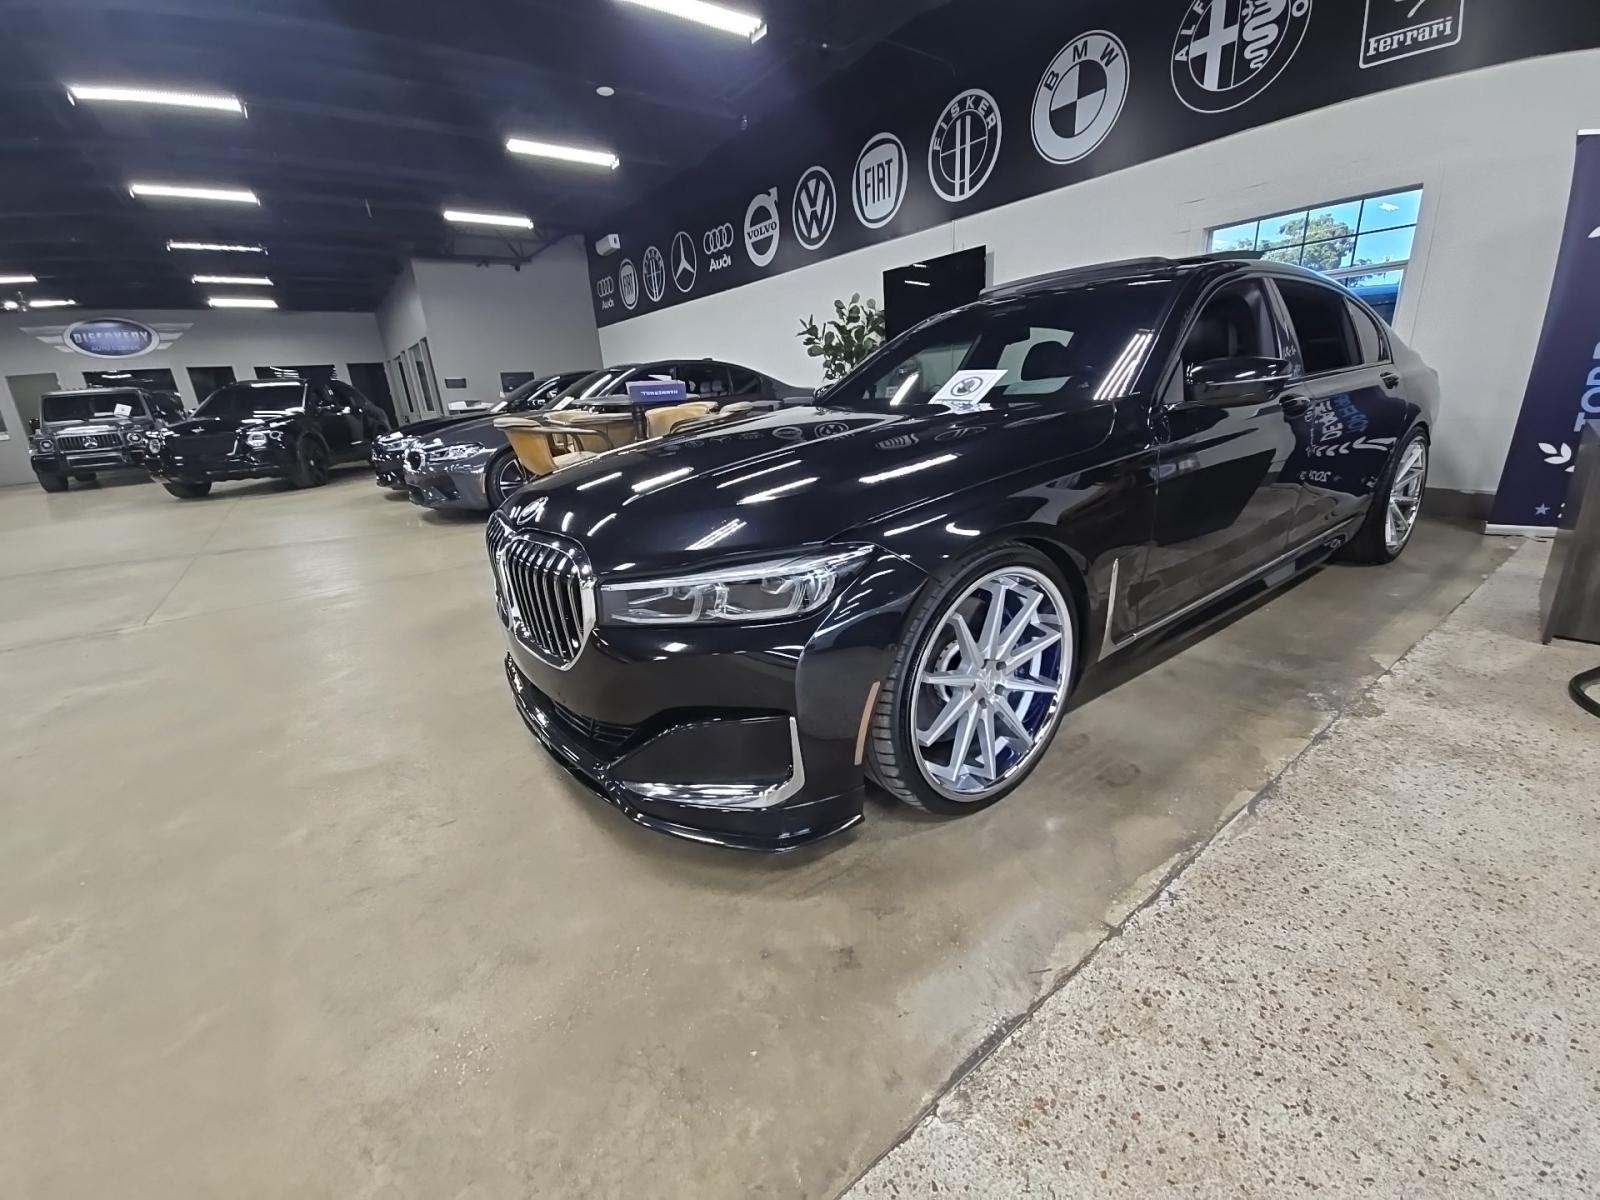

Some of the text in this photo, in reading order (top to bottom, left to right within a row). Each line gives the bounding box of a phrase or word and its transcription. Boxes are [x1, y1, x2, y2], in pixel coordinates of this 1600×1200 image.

[1366, 16, 1453, 57] Ferrari
[1044, 39, 1119, 92] BMW
[933, 95, 997, 150] FISKER
[864, 158, 893, 207] FIAT
[746, 221, 778, 241] VOLVO
[709, 254, 732, 273] Audi
